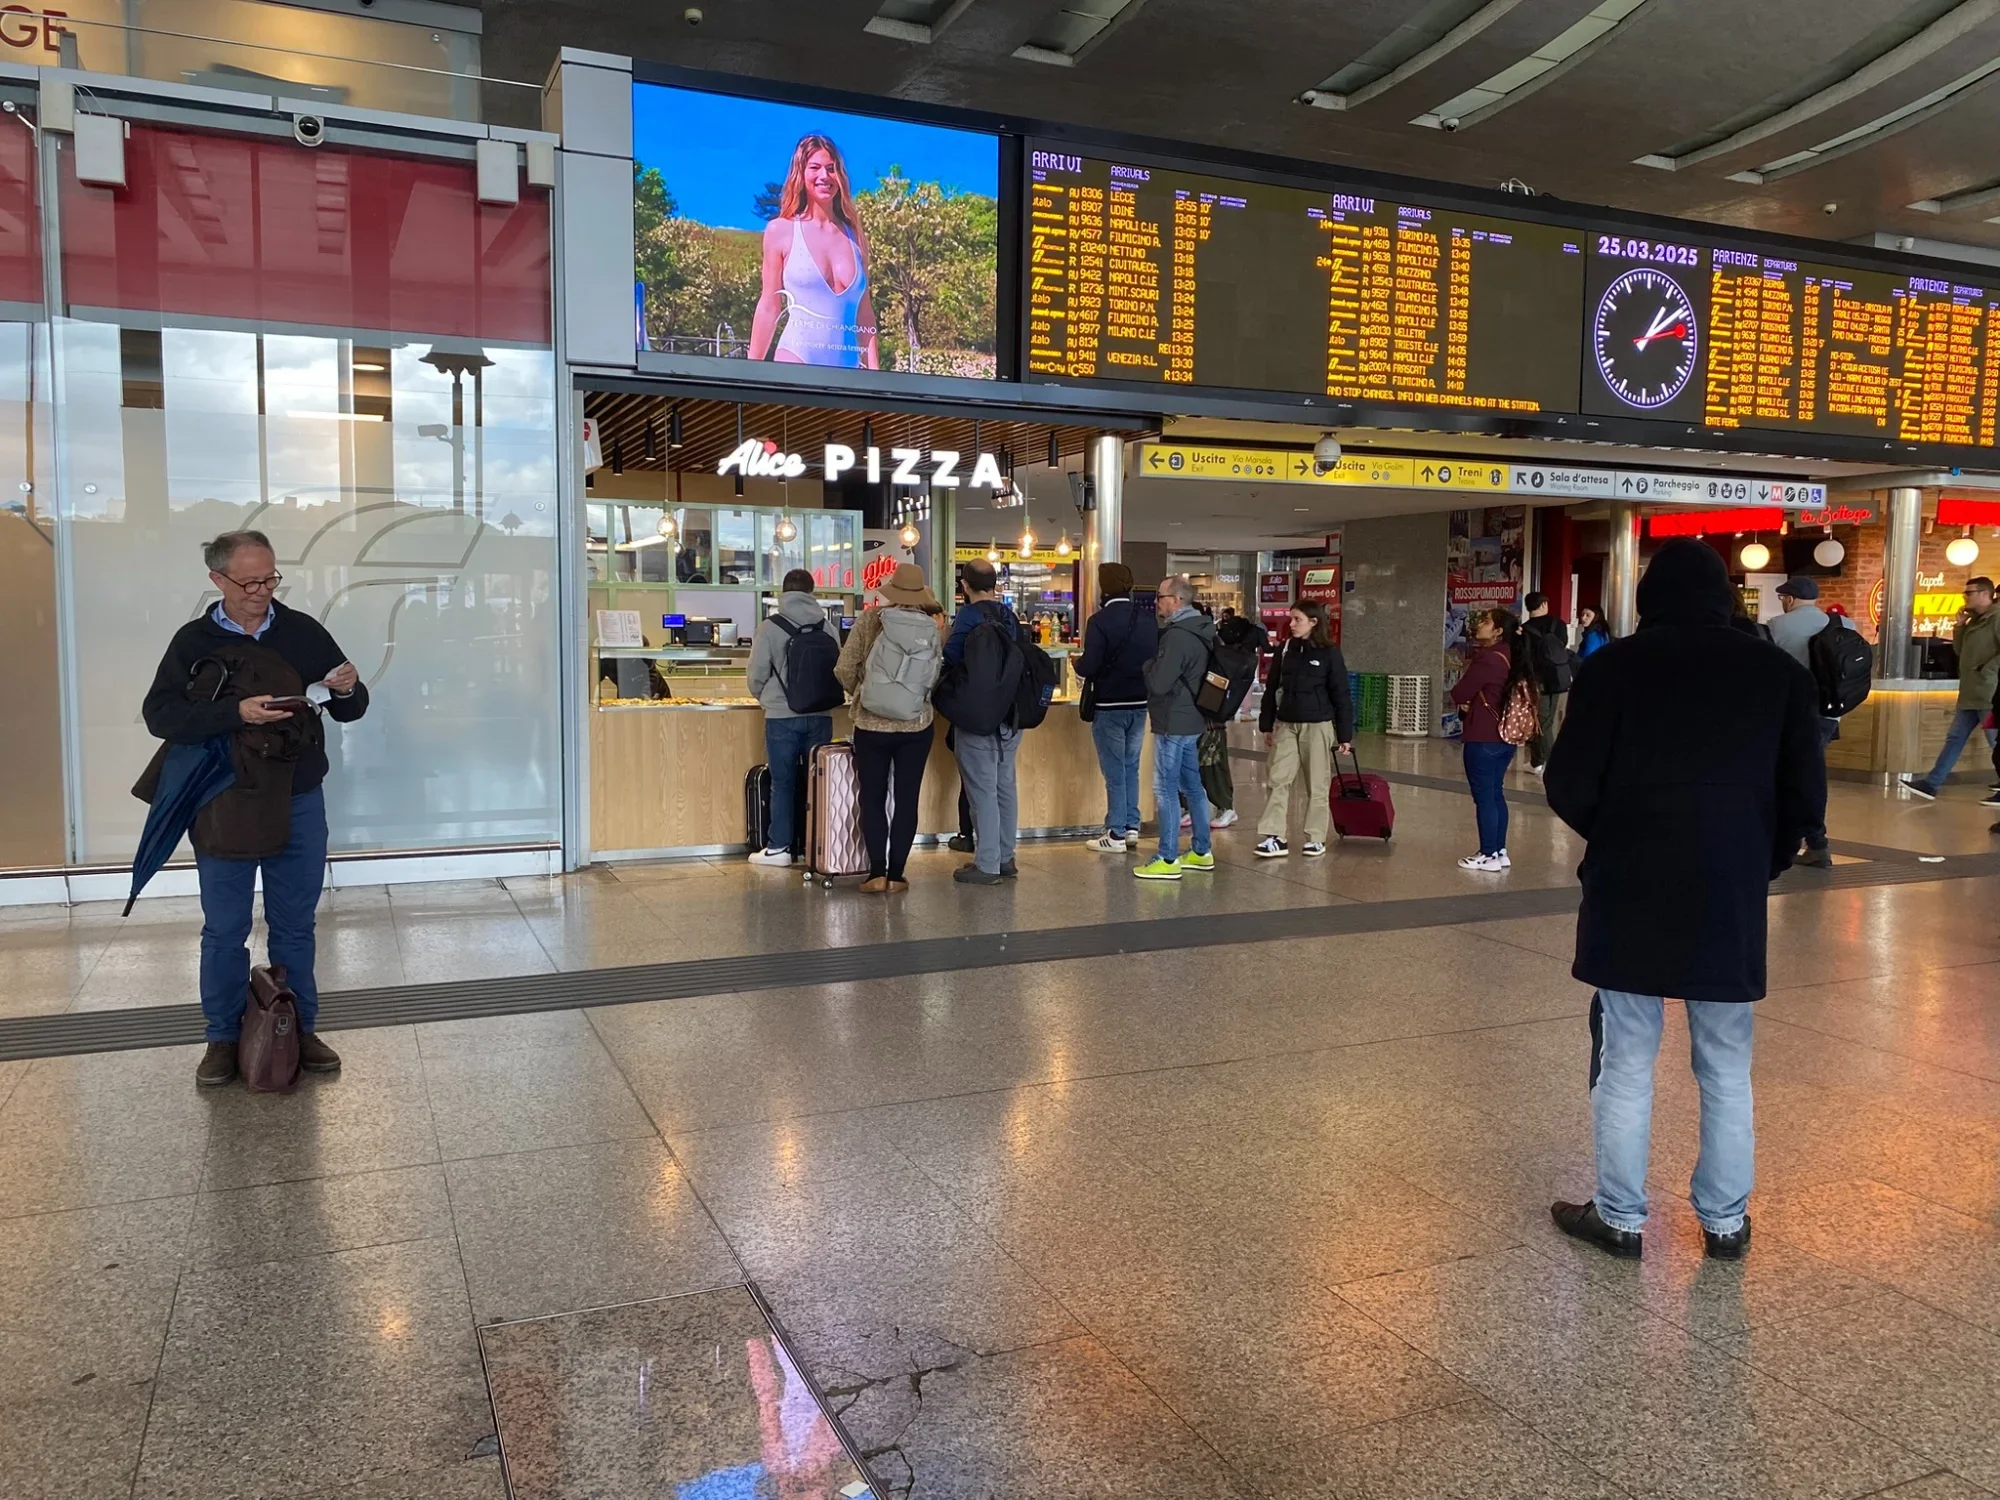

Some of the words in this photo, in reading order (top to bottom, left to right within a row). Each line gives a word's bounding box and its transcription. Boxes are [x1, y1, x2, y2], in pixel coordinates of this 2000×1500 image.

[1032, 151, 1082, 172] ARRIVI
[1111, 166, 1150, 180] ARRIVALS
[1070, 188, 1079, 198] AV
[1082, 187, 1103, 199] 8306
[1111, 191, 1135, 204] LECCE
[1176, 200, 1197, 212] 12:55
[1333, 194, 1375, 214] ARRIVI
[1398, 207, 1431, 220] ARRIVALS
[1069, 202, 1079, 212] AV
[1081, 201, 1102, 212] 8907
[1110, 205, 1134, 217] UDINE
[1175, 213, 1196, 225] 13:05
[1069, 216, 1079, 225] AV
[1081, 215, 1102, 226] 9636
[1110, 218, 1138, 231] NAPOLI
[1141, 222, 1158, 234] C.LE
[1175, 227, 1196, 238] 13:05
[1081, 228, 1102, 240] 4577
[1110, 232, 1150, 245] FIUMICINO
[1153, 237, 1161, 247] A.
[1174, 240, 1194, 251] 13:10
[1398, 230, 1422, 241] TORINO
[1452, 238, 1470, 248] 13:35
[1080, 242, 1107, 254] 20240
[1110, 245, 1145, 258] NETTUNO
[1598, 236, 1698, 266] 25.03.2025
[1080, 256, 1103, 268] 12541
[1109, 259, 1159, 274] CIVITAVECC.
[1397, 255, 1420, 266] NAPOLI
[1451, 262, 1469, 271] 13:40
[1713, 249, 1758, 267] PARTENZE
[1764, 258, 1797, 272] DEPARTURES
[1068, 270, 1078, 280] AV
[1080, 269, 1101, 281] 9422
[1109, 272, 1137, 284] NAPOLI
[1140, 275, 1157, 286] C.LE
[1174, 279, 1195, 290] 13:20
[1397, 267, 1431, 279] AVEZZANO
[1080, 283, 1104, 295] 12736
[1109, 285, 1159, 300] MINT.SCAURI
[1173, 292, 1195, 304] 13:24
[1910, 276, 1949, 294] PARTENZE
[1953, 285, 1983, 297] DEPARTURES
[1068, 297, 1078, 307] AV
[1080, 296, 1101, 308] 9923
[1109, 298, 1138, 311] TORINO
[1140, 302, 1155, 313] P.N.
[1173, 306, 1194, 317] 13:24
[790, 319, 814, 328] TERME
[826, 324, 876, 334] CHIANCIANO
[1080, 310, 1099, 320] 4617
[1108, 312, 1149, 325] FIUMICINO
[1151, 317, 1159, 327] A.
[1173, 319, 1194, 330] 13:25
[1067, 324, 1077, 334] AV
[1079, 323, 1100, 334] 9977
[1108, 326, 1136, 338] MILANO
[1138, 329, 1156, 339] C.LE
[1172, 332, 1193, 343] 13:25
[1395, 328, 1426, 339] VELLETRI
[848, 345, 868, 353] tempo
[1067, 338, 1077, 348] AV
[1079, 337, 1098, 348] 8134
[1172, 345, 1193, 356] 13:30
[1395, 340, 1422, 351] TRIESTE
[1067, 352, 1077, 361] AV
[1079, 350, 1096, 361] 9411
[1107, 352, 1141, 365] VENEZIA
[1143, 356, 1157, 366] S.L.
[1172, 358, 1193, 369] 13:30
[1079, 364, 1094, 374] 550
[1171, 371, 1192, 382] 13:34
[1393, 364, 1426, 375] FRASCATI
[1327, 387, 1341, 396] AND
[1344, 388, 1361, 398] STOP
[1398, 393, 1413, 401] INFO
[1415, 393, 1424, 402] ON
[1473, 397, 1486, 406] AND
[1498, 399, 1510, 408] THE
[716, 437, 807, 477] Alice
[824, 443, 1003, 488] PIZZA
[1192, 453, 1225, 464] Uscita
[1246, 456, 1272, 464] Marsala
[1458, 467, 1482, 477] Treni
[1550, 472, 1569, 482] Sala
[1573, 474, 1608, 484] d'attesa
[1653, 478, 1700, 491] Parcheggio
[1653, 488, 1672, 497] Parking
[1817, 505, 1872, 525] Bottega
[1455, 586, 1514, 600] ROSSOPOMODORO
